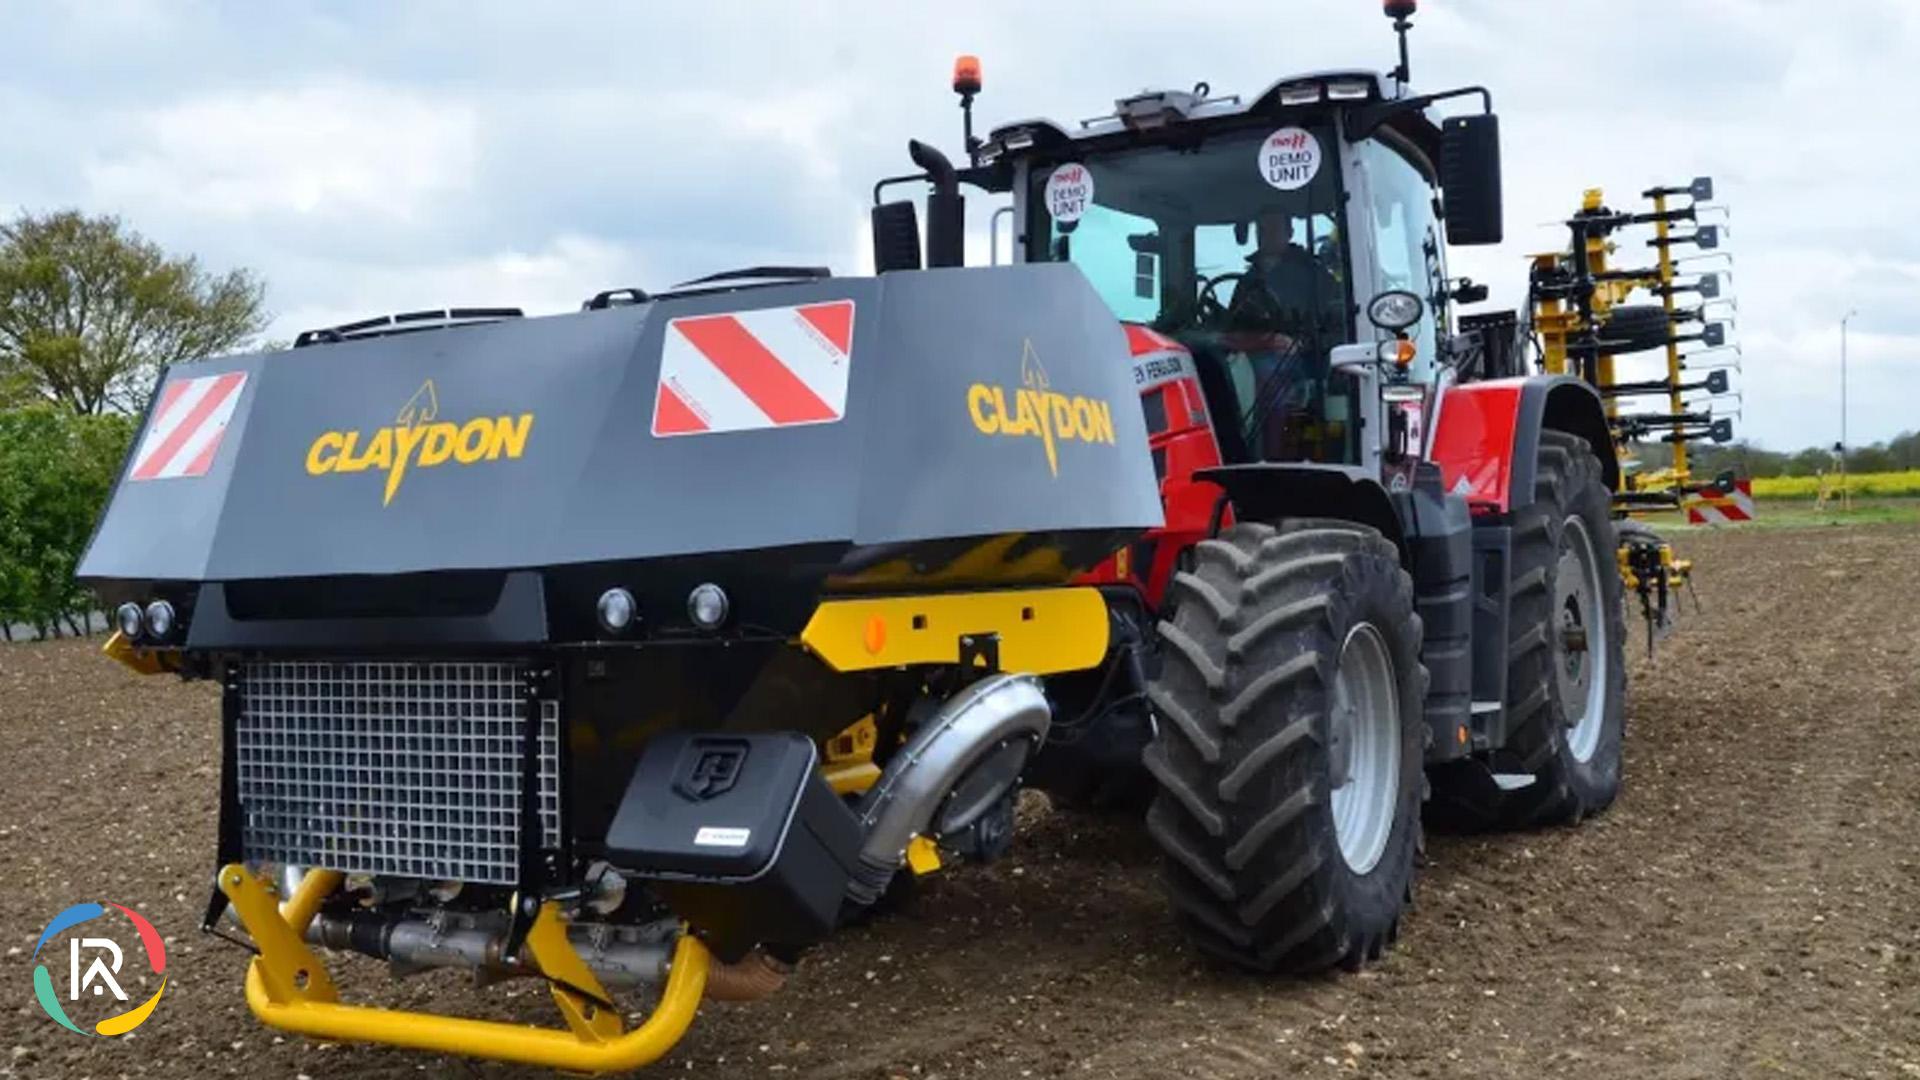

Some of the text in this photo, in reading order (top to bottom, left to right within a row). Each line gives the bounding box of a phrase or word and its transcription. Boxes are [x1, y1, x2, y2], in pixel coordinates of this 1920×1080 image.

[1269, 150, 1312, 168] DEMO
[1269, 165, 1312, 183] UNIT
[1053, 184, 1086, 202] DEMO
[1053, 199, 1086, 217] UNIT
[967, 383, 1116, 477] CLAYDON
[305, 413, 534, 507] CLAYDON
